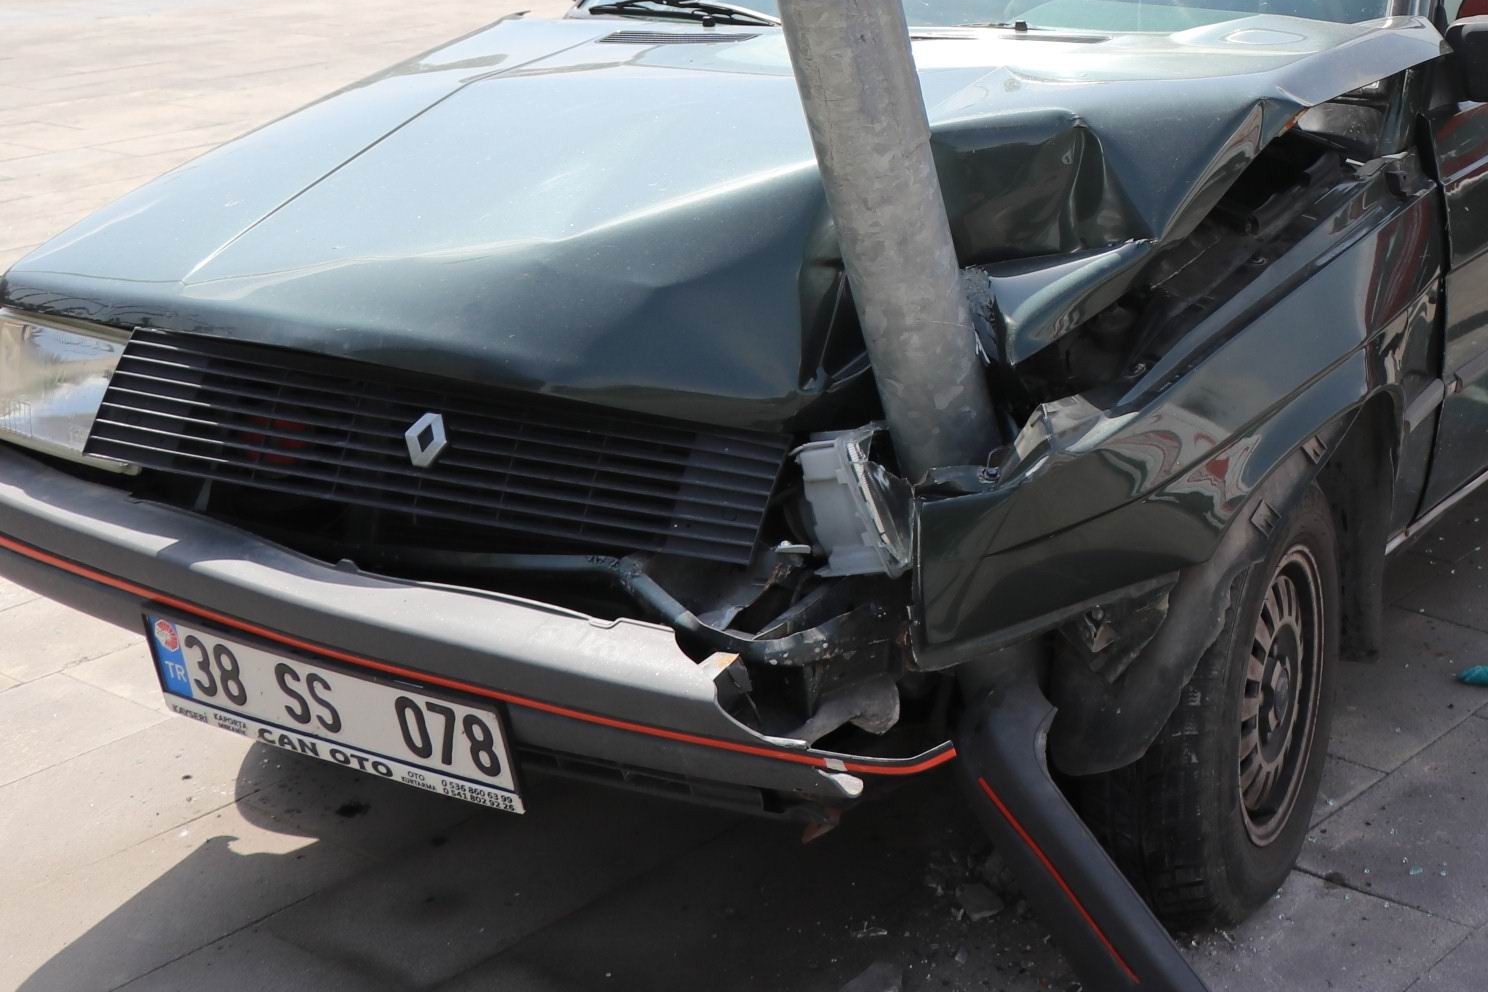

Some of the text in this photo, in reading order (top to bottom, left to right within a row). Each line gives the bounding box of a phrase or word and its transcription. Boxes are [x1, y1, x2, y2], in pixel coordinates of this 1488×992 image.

[164, 660, 188, 683] TR
[184, 634, 501, 778] 38 SS 078
[257, 727, 394, 778] CAN OTO
[407, 770, 426, 782] OTO
